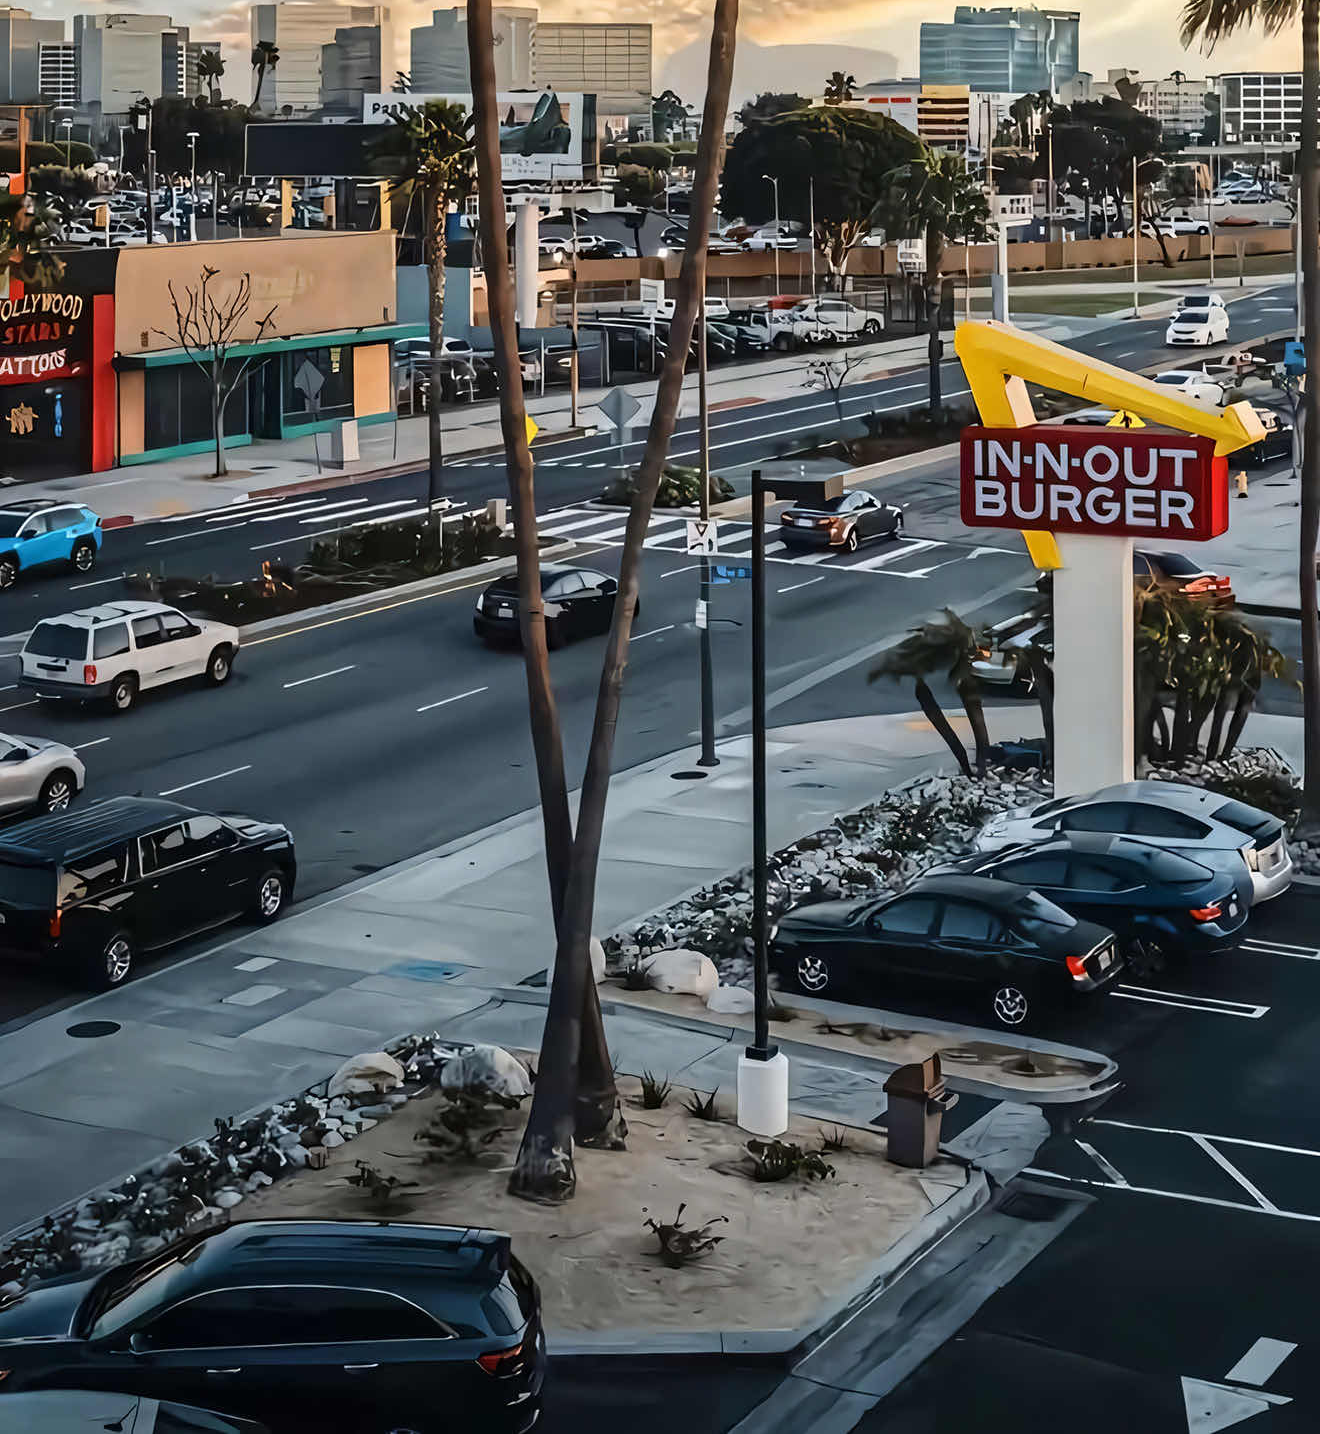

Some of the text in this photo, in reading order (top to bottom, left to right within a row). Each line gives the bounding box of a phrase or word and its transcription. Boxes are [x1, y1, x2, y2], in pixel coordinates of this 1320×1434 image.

[0, 293, 83, 322] OLLYWOOD
[0, 348, 67, 377] ATTOOS
[973, 439, 1198, 487] IN-N-OUT
[974, 479, 1195, 529] BURGER
